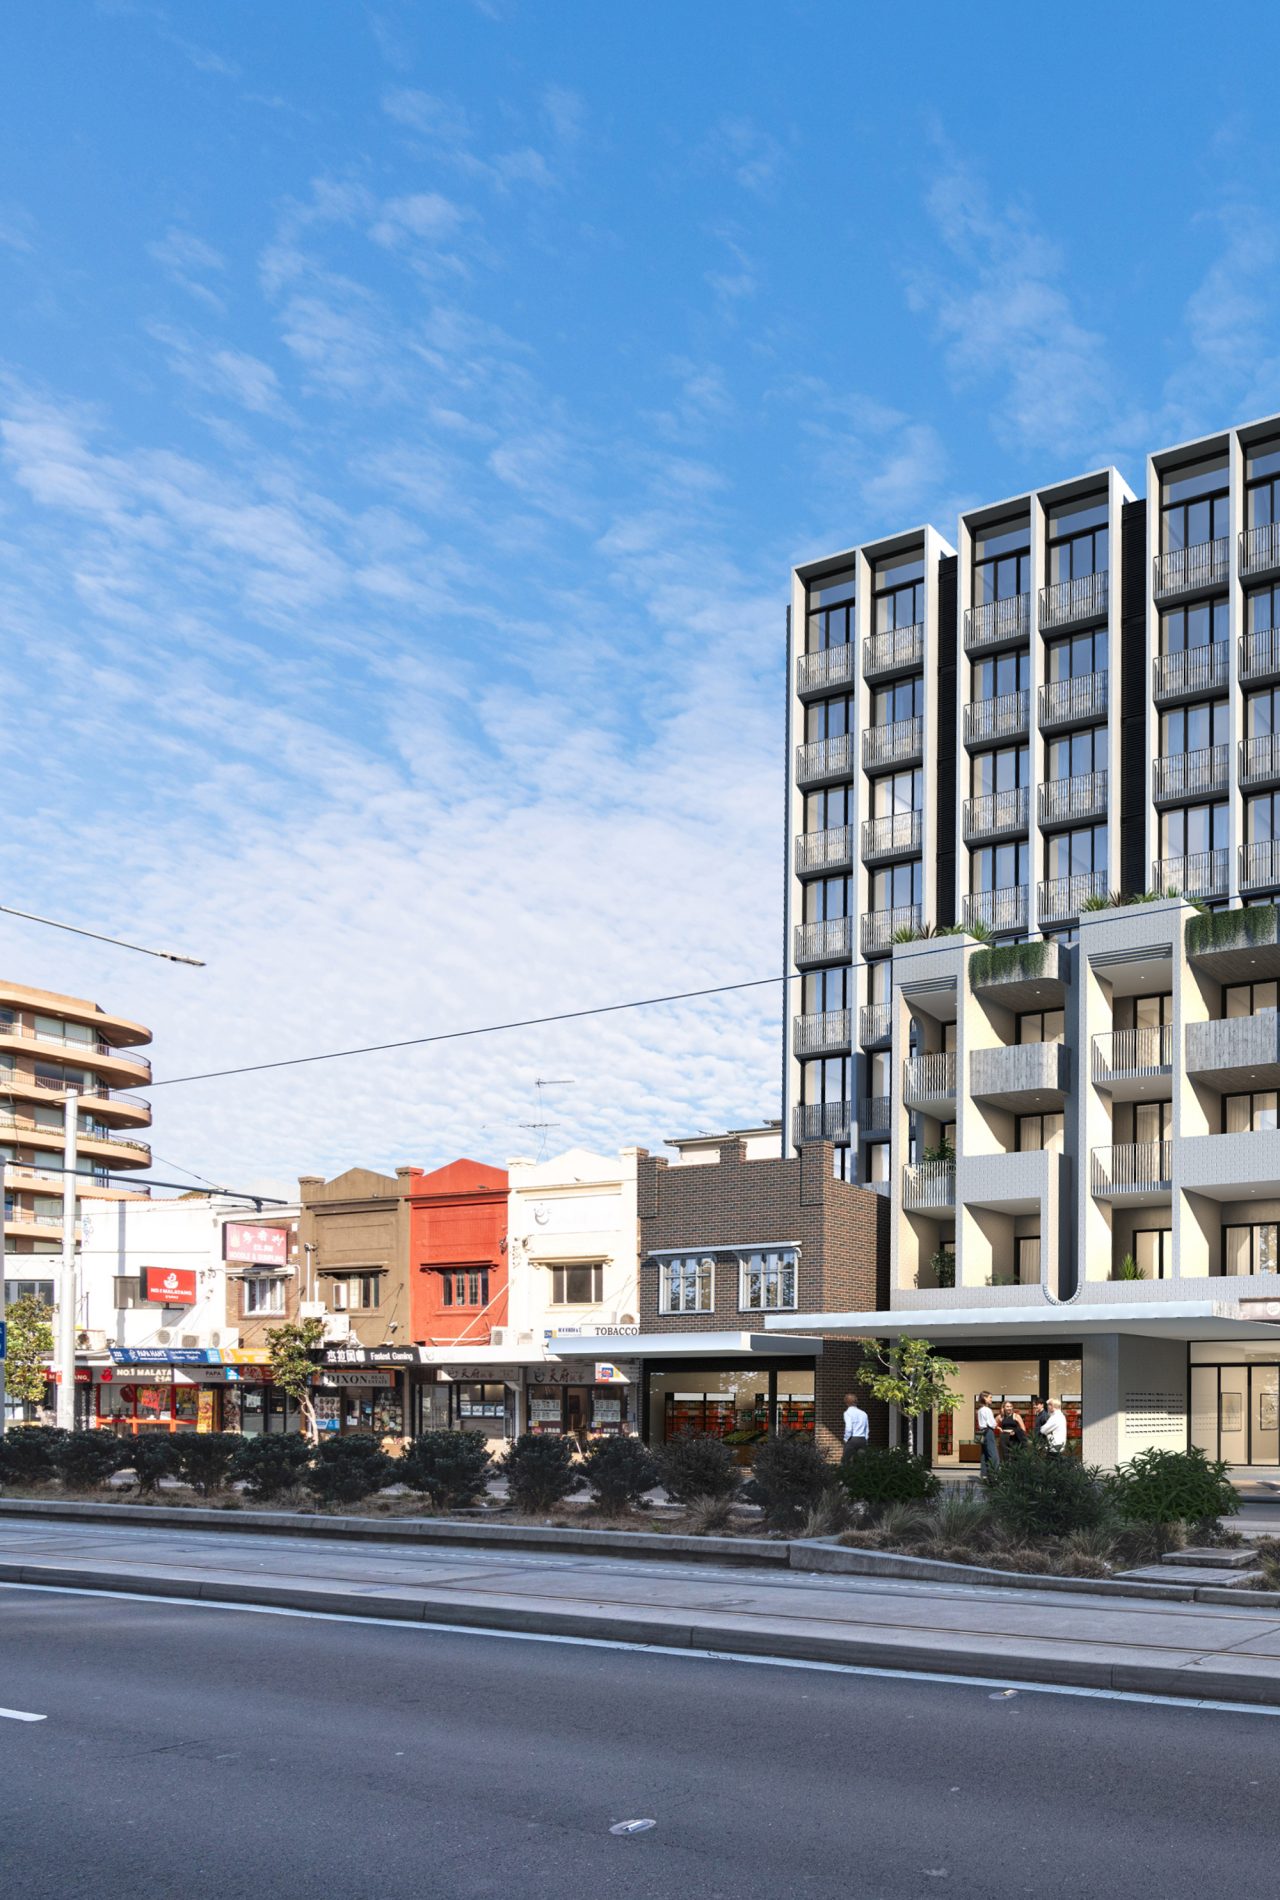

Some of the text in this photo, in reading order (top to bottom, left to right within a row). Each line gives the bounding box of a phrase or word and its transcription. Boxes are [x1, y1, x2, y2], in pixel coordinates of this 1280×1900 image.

[594, 1326, 640, 1336] TOBACCO
[370, 1352, 414, 1362] Fastest Gaming
[116, 1368, 135, 1376] NO.1
[327, 1374, 368, 1385] DIXON
